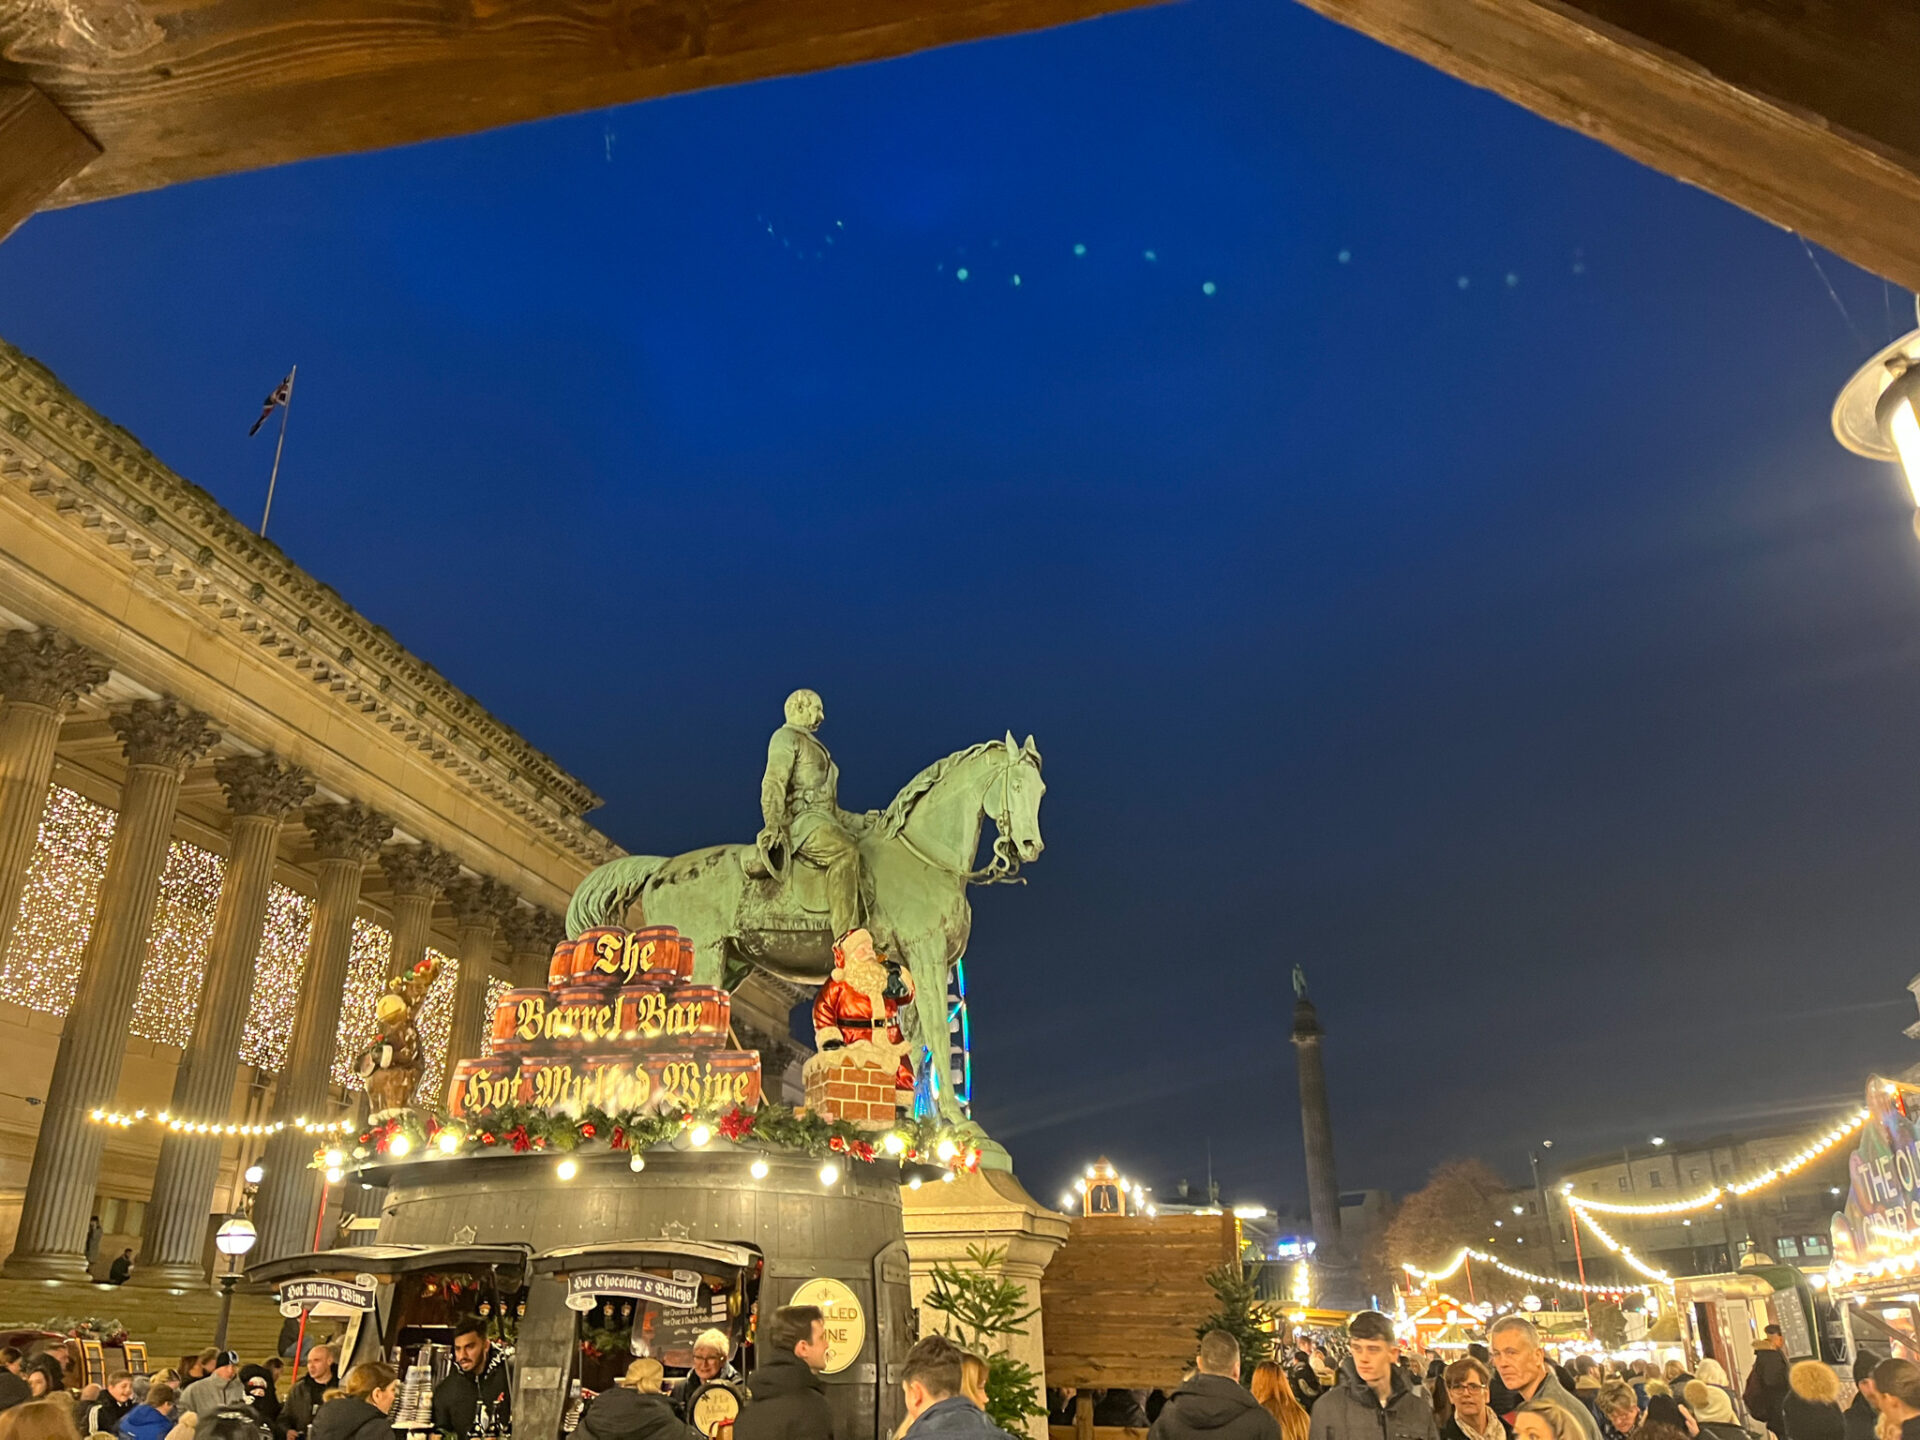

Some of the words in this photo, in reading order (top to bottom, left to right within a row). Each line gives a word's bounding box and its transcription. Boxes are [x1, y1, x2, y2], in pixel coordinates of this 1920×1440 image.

[594, 932, 656, 984] The
[515, 994, 626, 1041] Barrel
[637, 992, 703, 1038] Bar
[464, 1066, 523, 1114] Hot
[659, 1060, 749, 1107] Wine
[1858, 1154, 1898, 1204] THE
[287, 1284, 304, 1299] Hot
[306, 1283, 339, 1299] Mulled
[341, 1287, 366, 1306] Wine
[574, 1275, 592, 1291] Hot
[594, 1274, 642, 1290] Chocolate
[644, 1281, 652, 1293] &
[655, 1282, 692, 1304] Baileys
[821, 1306, 858, 1320] LLED
[824, 1328, 848, 1341] INE
